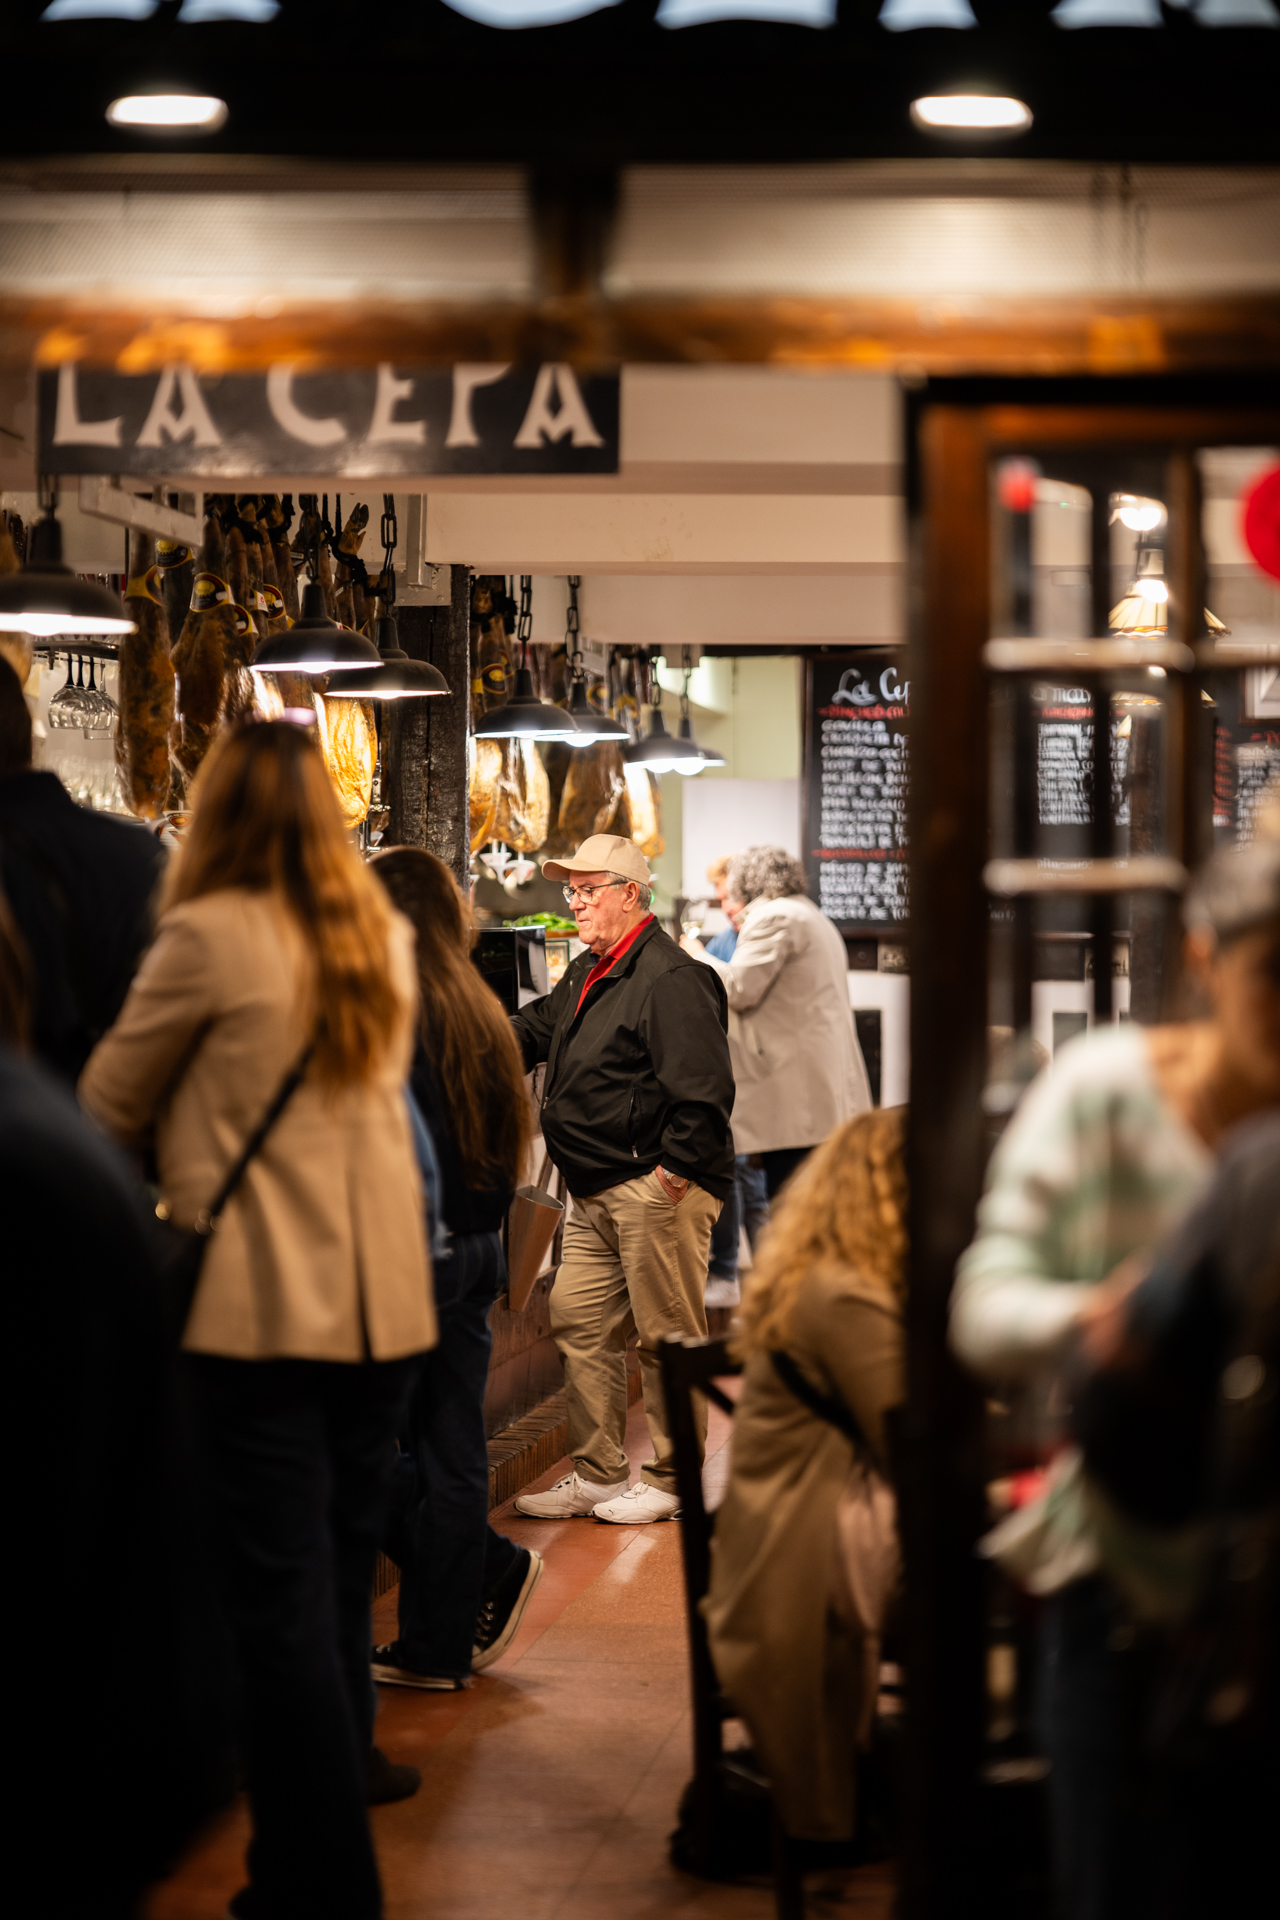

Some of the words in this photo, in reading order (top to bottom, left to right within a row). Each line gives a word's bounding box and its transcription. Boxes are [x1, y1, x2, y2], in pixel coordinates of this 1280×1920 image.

[52, 362, 222, 448] LA
[266, 362, 605, 448] CEPA
[831, 668, 879, 706] La
